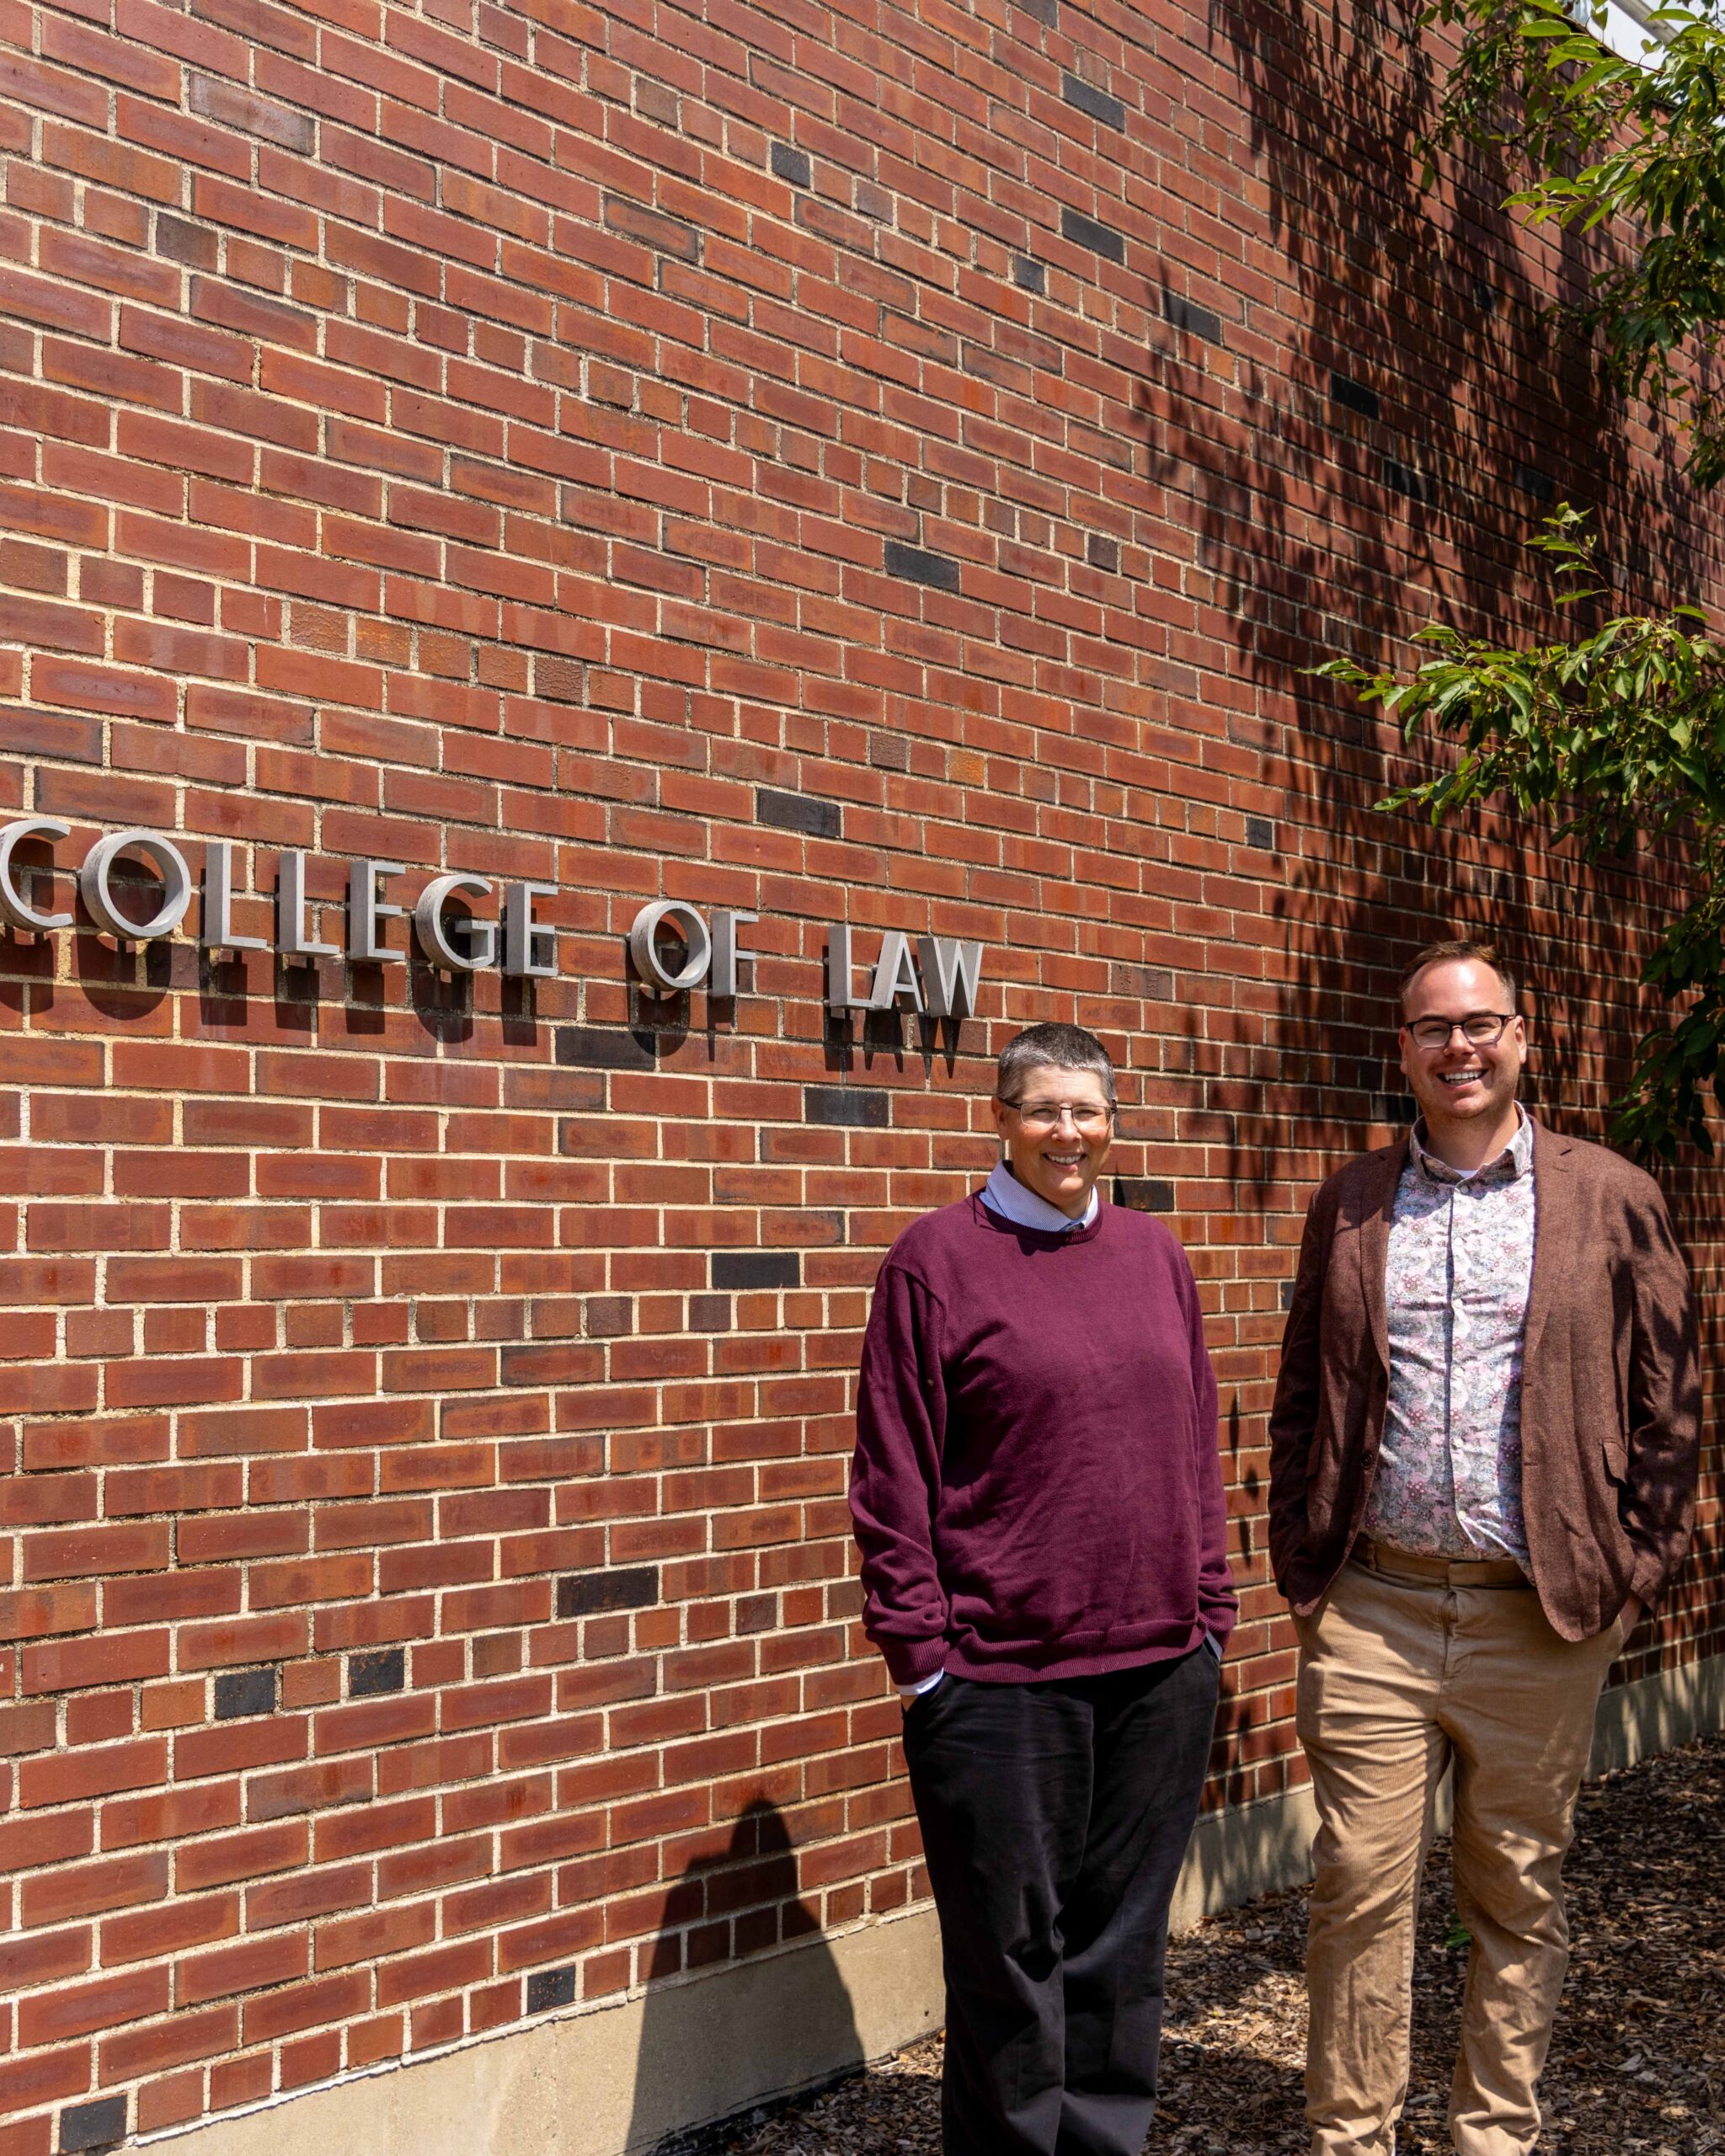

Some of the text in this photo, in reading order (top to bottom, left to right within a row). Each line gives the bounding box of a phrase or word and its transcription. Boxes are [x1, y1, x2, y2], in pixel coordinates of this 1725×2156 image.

[0, 818, 984, 1017] COLLEGE OF LAW
